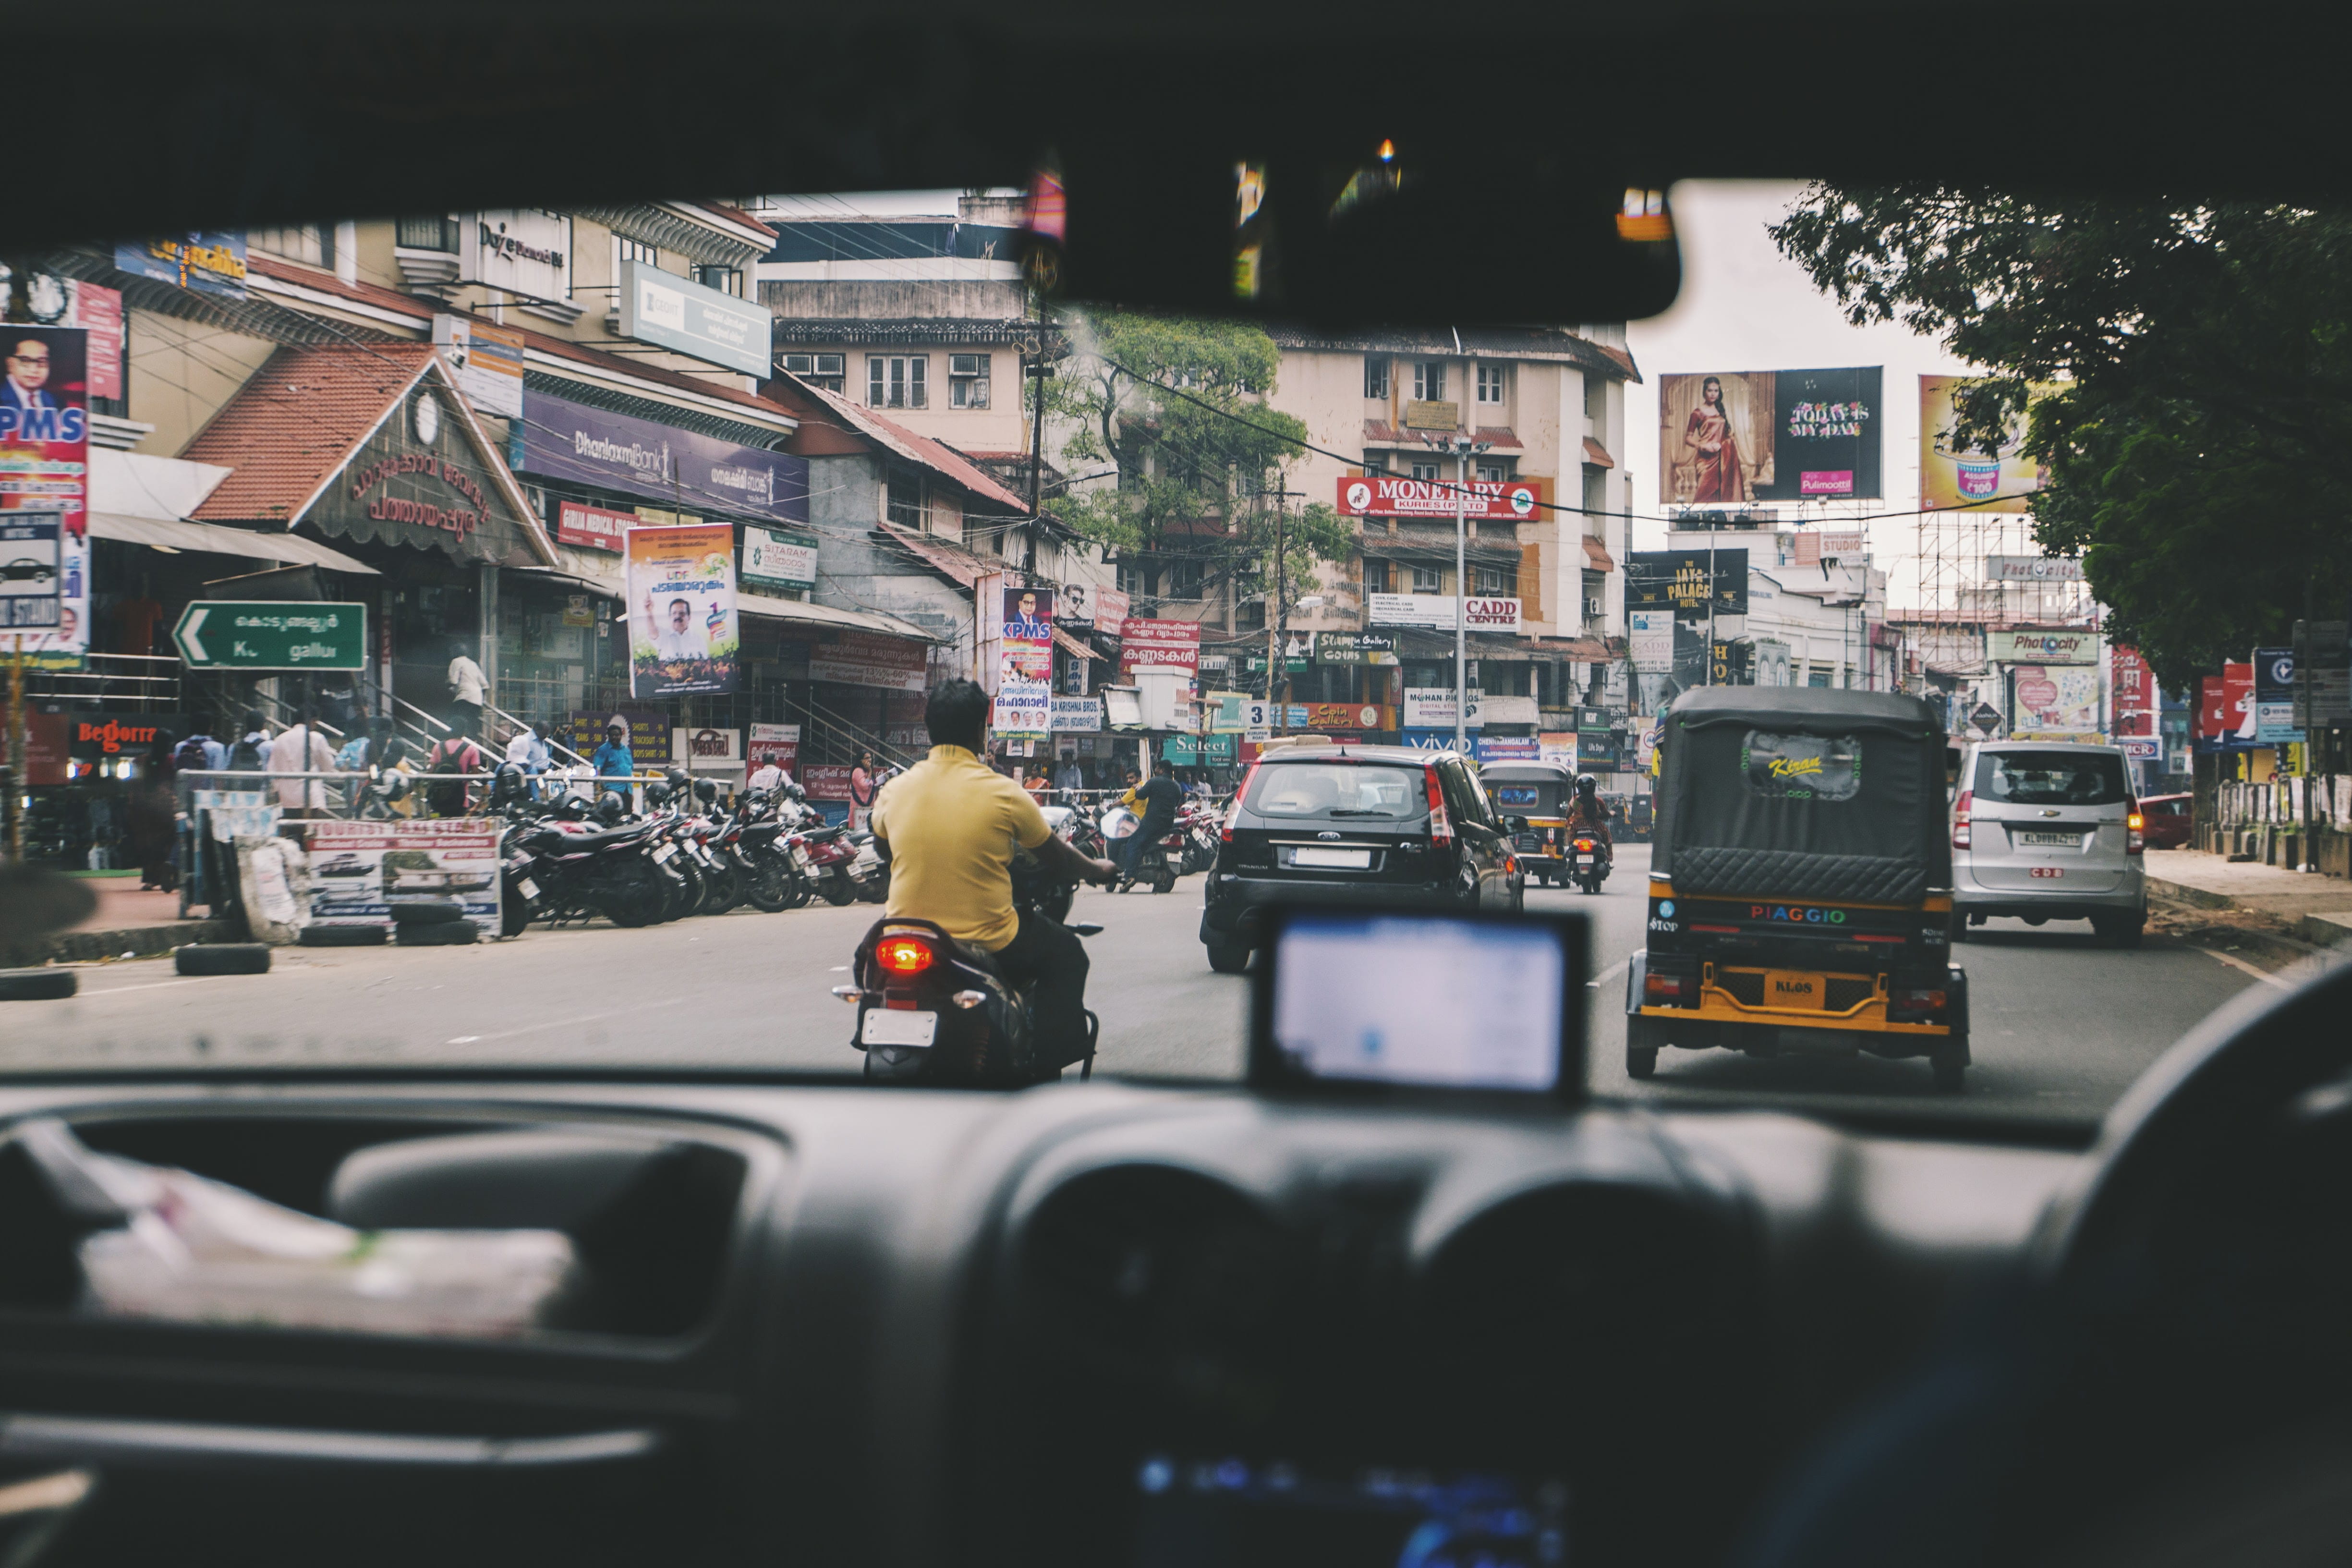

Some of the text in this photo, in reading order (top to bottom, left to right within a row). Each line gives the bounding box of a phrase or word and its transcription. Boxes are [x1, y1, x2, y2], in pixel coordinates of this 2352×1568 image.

[1793, 408, 1869, 422] TODAY IS
[1794, 422, 1856, 437] MY DAY
[1377, 480, 1505, 502] MONETARY
[1803, 480, 1851, 489] Pulimoottil
[585, 512, 614, 536] MEDICAL
[764, 544, 807, 558] SITARAM
[1824, 540, 1860, 551] STUDIO
[667, 571, 690, 580] UDF
[1676, 568, 1703, 583] JAYA
[1667, 583, 1710, 600] PALACE
[1466, 600, 1517, 615] CADD
[1466, 615, 1516, 624] CENTRE
[1003, 622, 1051, 640] KPMS
[1363, 635, 1391, 649] Gallery
[2014, 636, 2081, 654] Photocity
[1123, 648, 1196, 665] കണ്ണടകൾ
[996, 695, 1048, 707] മഹാറാലി
[1059, 701, 1082, 712] KRISHNA
[1083, 701, 1099, 712] BROS.
[1251, 706, 1263, 724] 3
[1318, 705, 1348, 717] Coin
[1308, 715, 1354, 728] Gallery
[1176, 737, 1226, 751] Select
[1410, 733, 1472, 752] vivo
[1596, 743, 1604, 753] Style
[1769, 756, 1823, 778] Kiran
[1751, 907, 1846, 924] PIAGGIO
